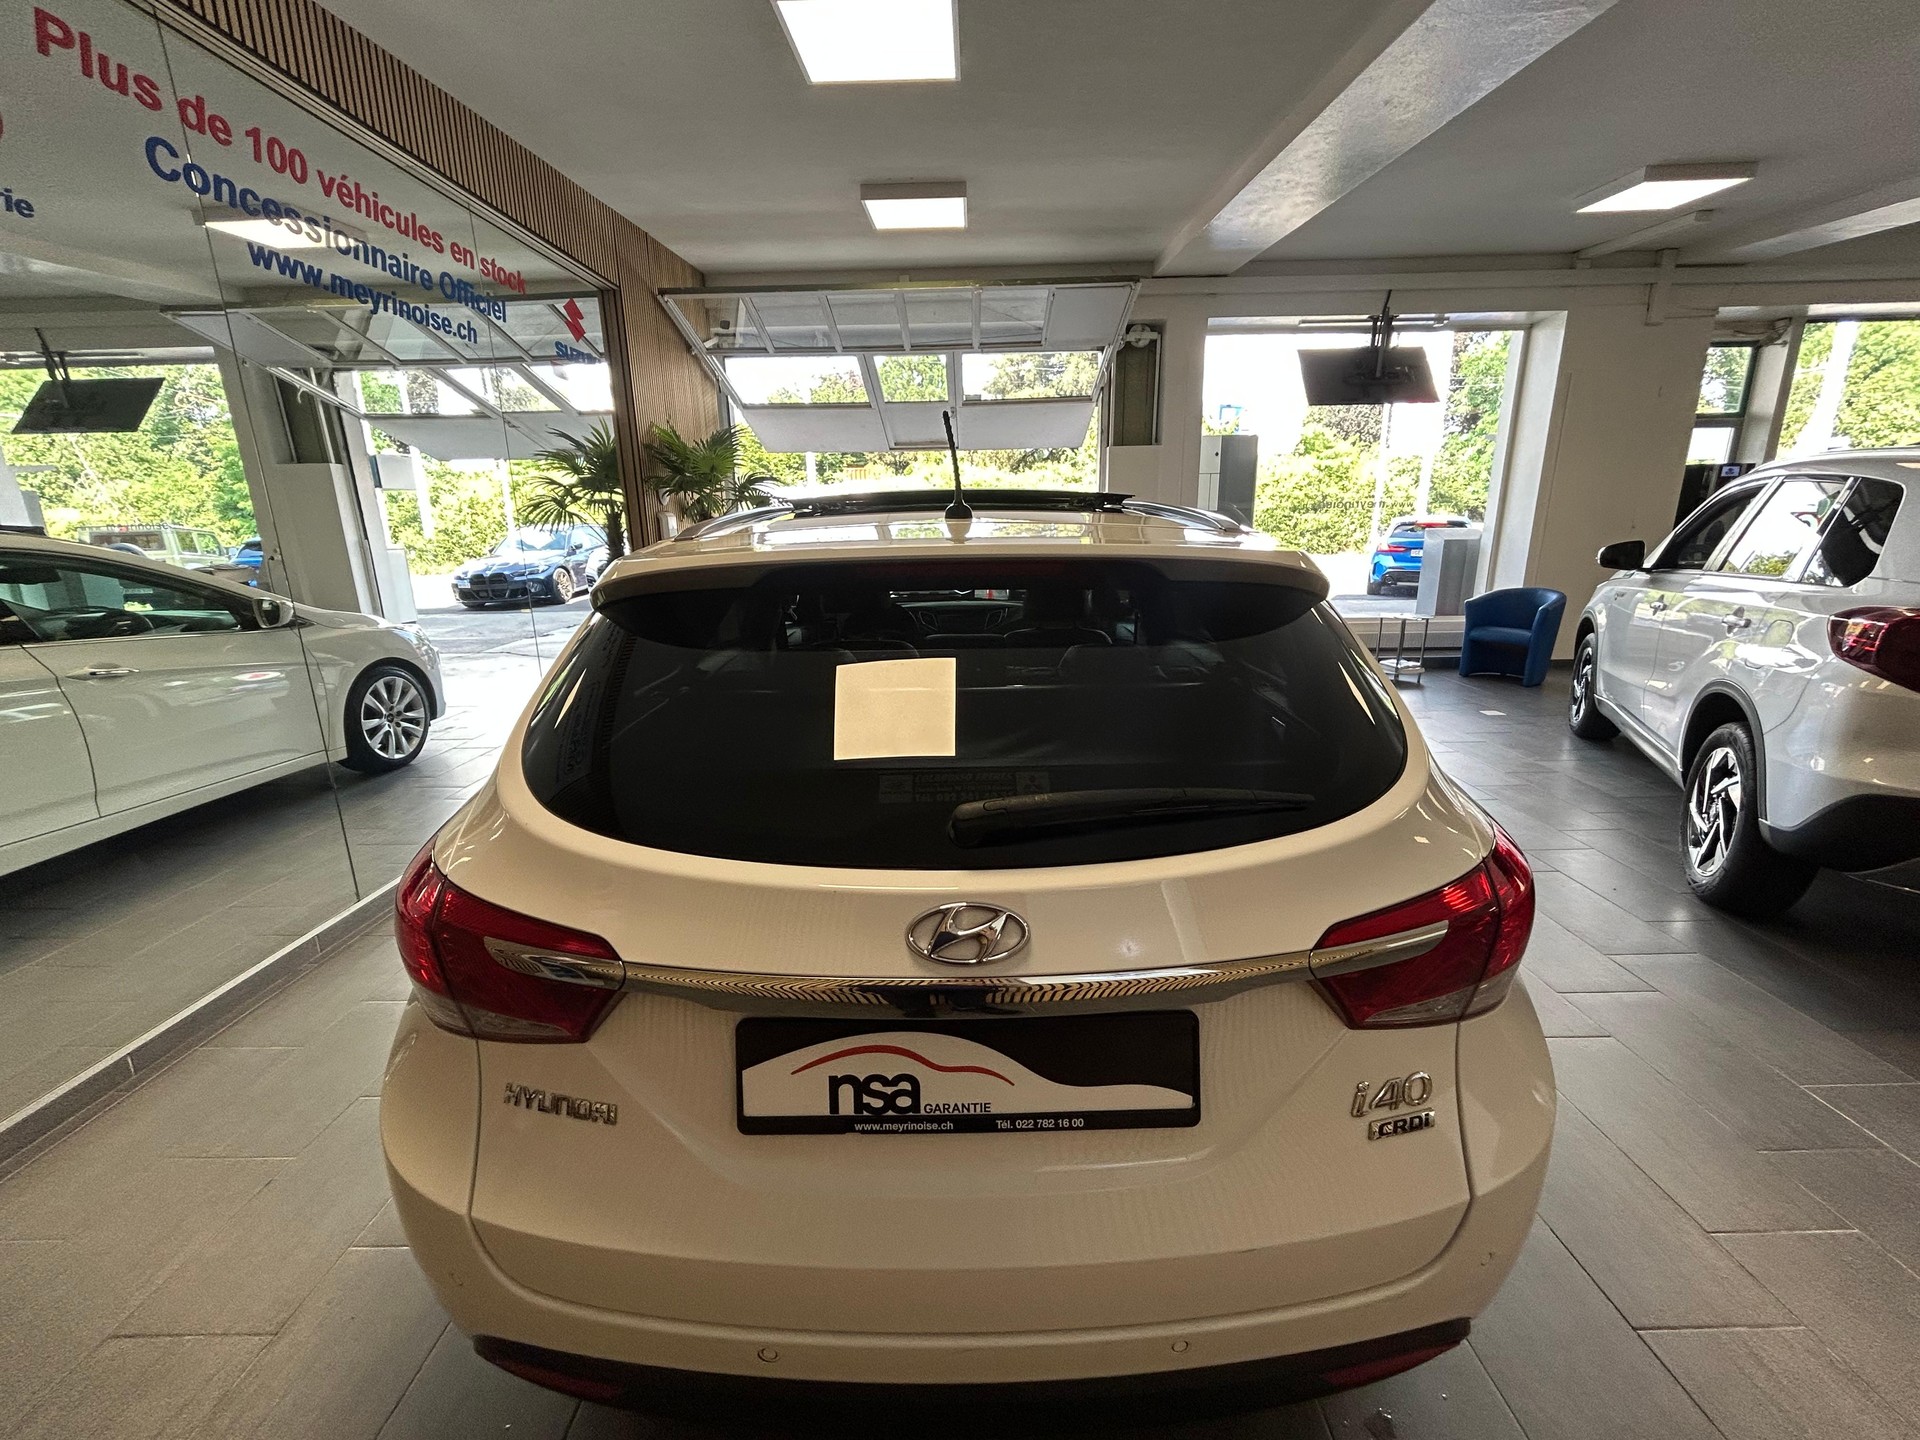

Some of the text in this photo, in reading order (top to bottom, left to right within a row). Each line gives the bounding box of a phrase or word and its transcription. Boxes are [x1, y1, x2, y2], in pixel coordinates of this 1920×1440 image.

[34, 6, 527, 295] Plus de 100 véhicules en stock
[0, 187, 35, 219] ie
[145, 136, 508, 323] Concessionnaire Officiel
[247, 241, 478, 345] www.meyrinoise.ch
[503, 1082, 618, 1126] HYUNDAI
[828, 1073, 921, 1115] nsa
[923, 1102, 992, 1114] GARANTIE
[1350, 1070, 1433, 1118] i40
[854, 1120, 954, 1132] www.meyrinoise.ch
[996, 1118, 1084, 1130] Tél. 022 782 16 00
[1378, 1112, 1431, 1136] CRDi
